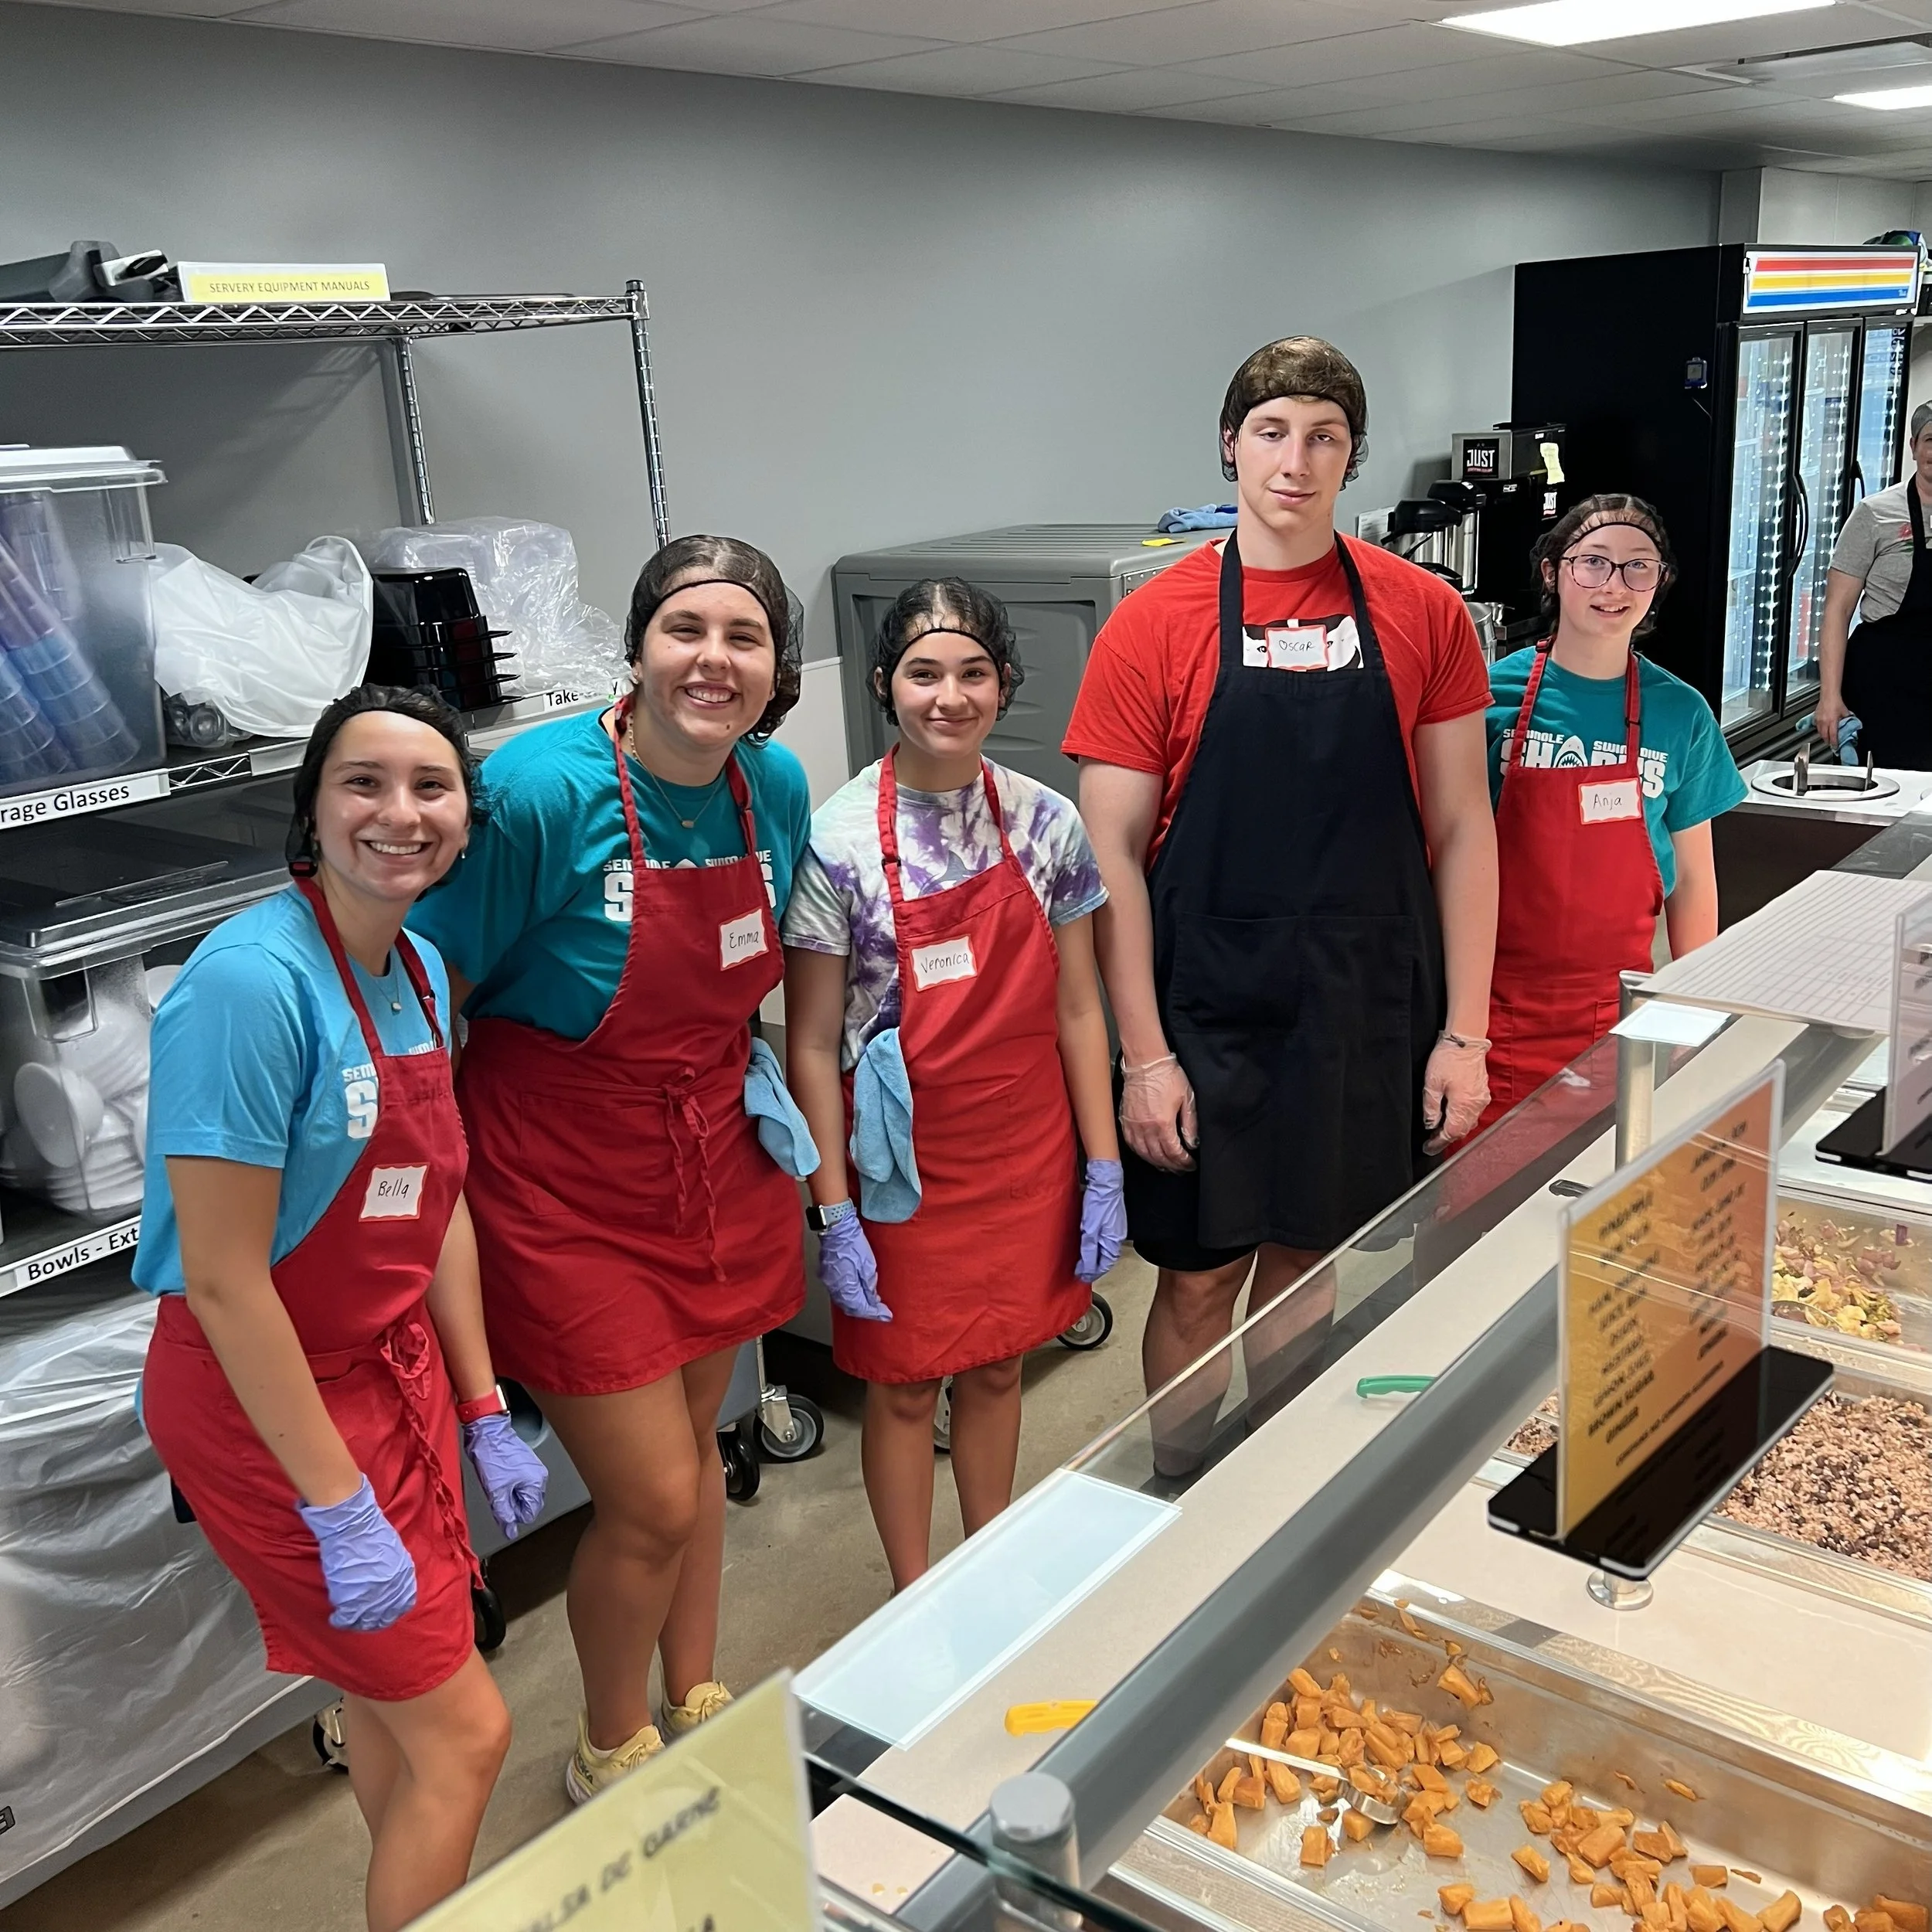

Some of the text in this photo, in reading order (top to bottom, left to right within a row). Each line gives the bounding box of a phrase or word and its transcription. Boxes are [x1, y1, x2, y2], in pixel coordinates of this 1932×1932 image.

[209, 281, 370, 294] SERVERY EQUIPMENT MANUALS
[1467, 449, 1495, 468] JUST
[53, 785, 130, 811] Glasses
[1593, 794, 1622, 811] Anja
[730, 930, 759, 949] Emma
[920, 953, 970, 974] Veronica
[377, 1177, 410, 1199] Bella
[28, 1247, 90, 1281] Bowls
